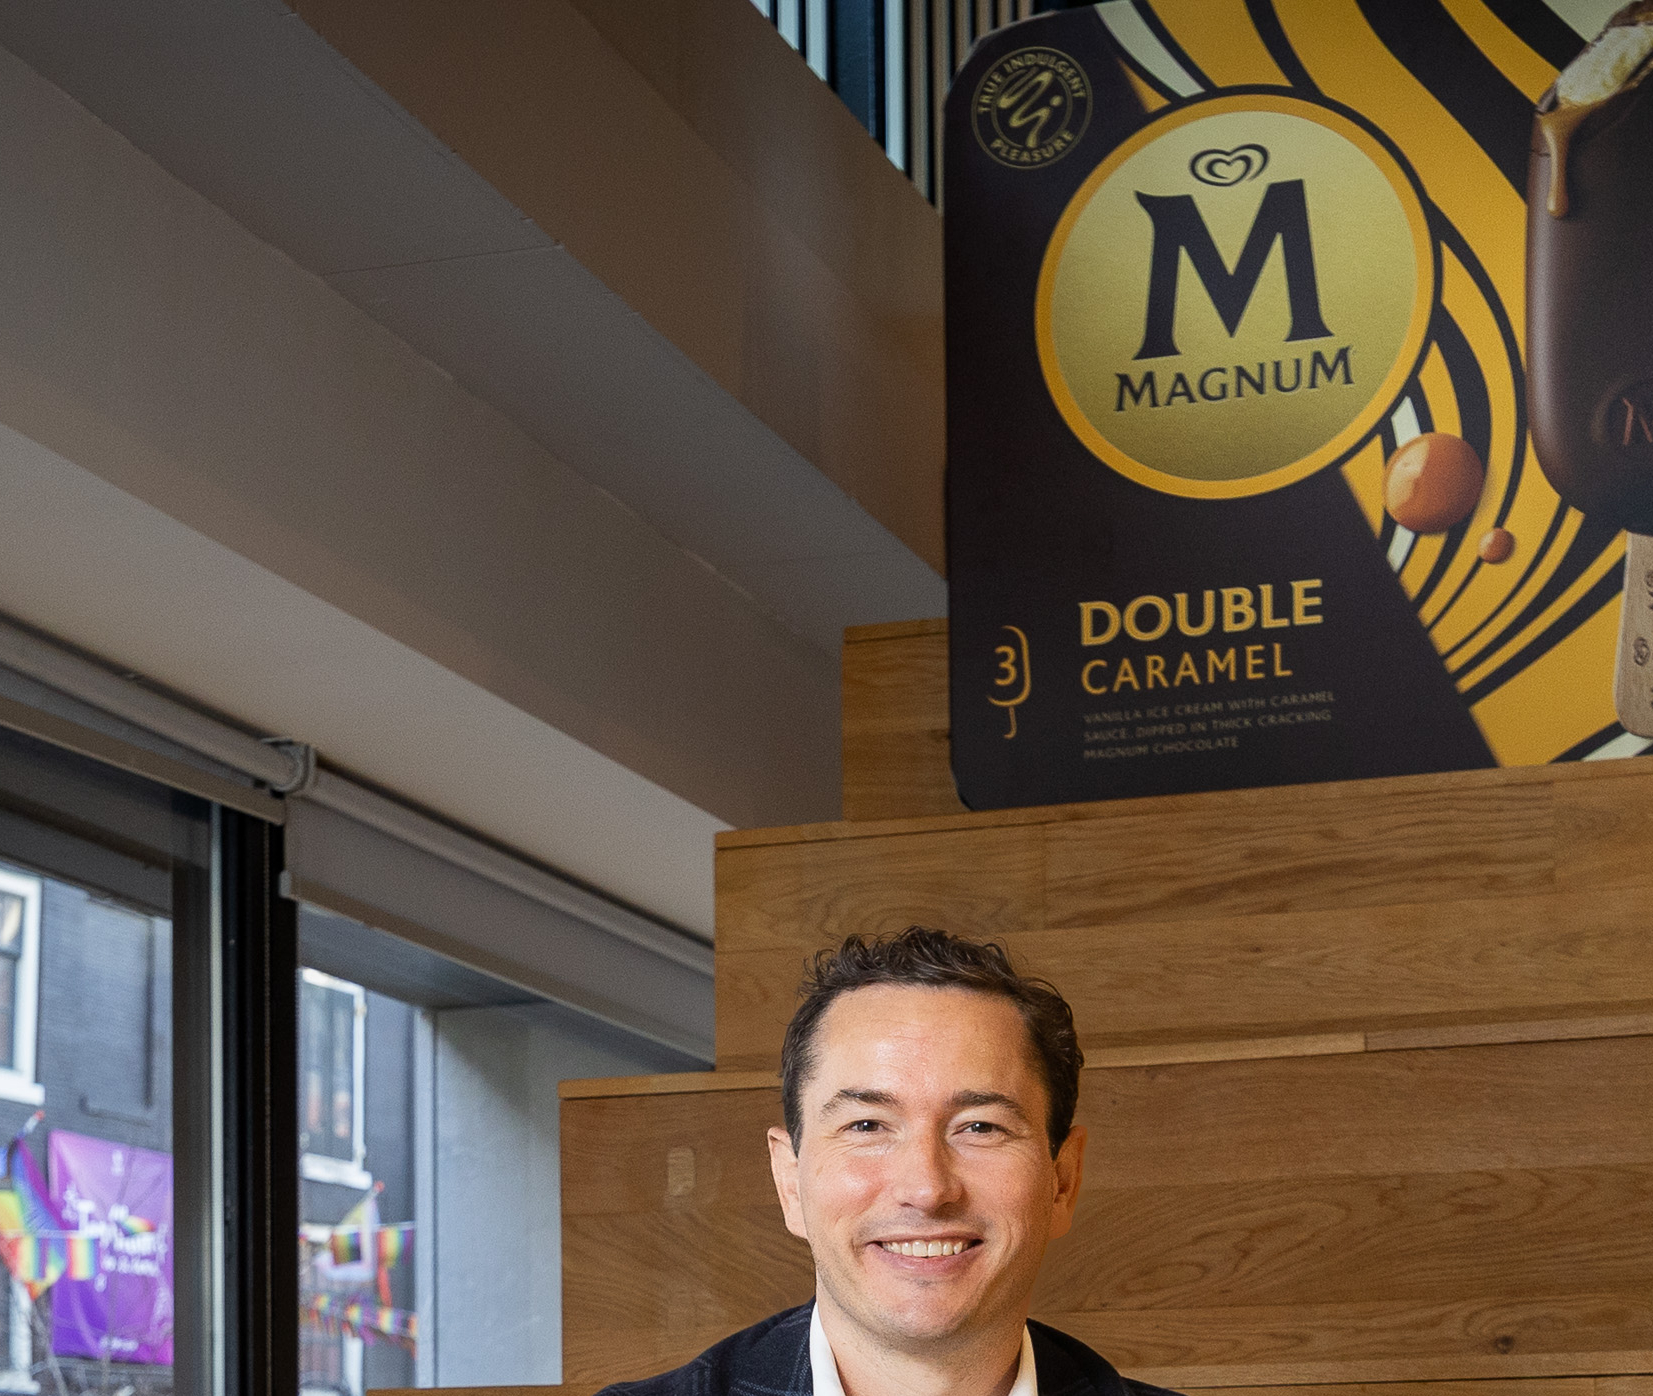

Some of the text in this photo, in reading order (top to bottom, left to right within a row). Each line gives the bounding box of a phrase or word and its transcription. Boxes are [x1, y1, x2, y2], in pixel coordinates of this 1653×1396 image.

[977, 52, 1086, 114] TRUE INDULGENT
[990, 129, 1075, 162] PLEASURE
[1131, 178, 1335, 361] M
[1113, 345, 1355, 412] MAGNUM
[1078, 578, 1324, 647] DOUBLE
[994, 645, 1017, 686] 3
[1081, 642, 1294, 695] CARAMEL
[1083, 690, 1335, 725] VANILLA ICE CREAM WITH CARAMEL
[1135, 722, 1187, 739] DIPPED
[1190, 720, 1207, 733] IN
[1212, 716, 1252, 731] THICK
[1257, 708, 1333, 728] CRACKING
[1083, 735, 1240, 760] MAGNUM CHOCOLATE
